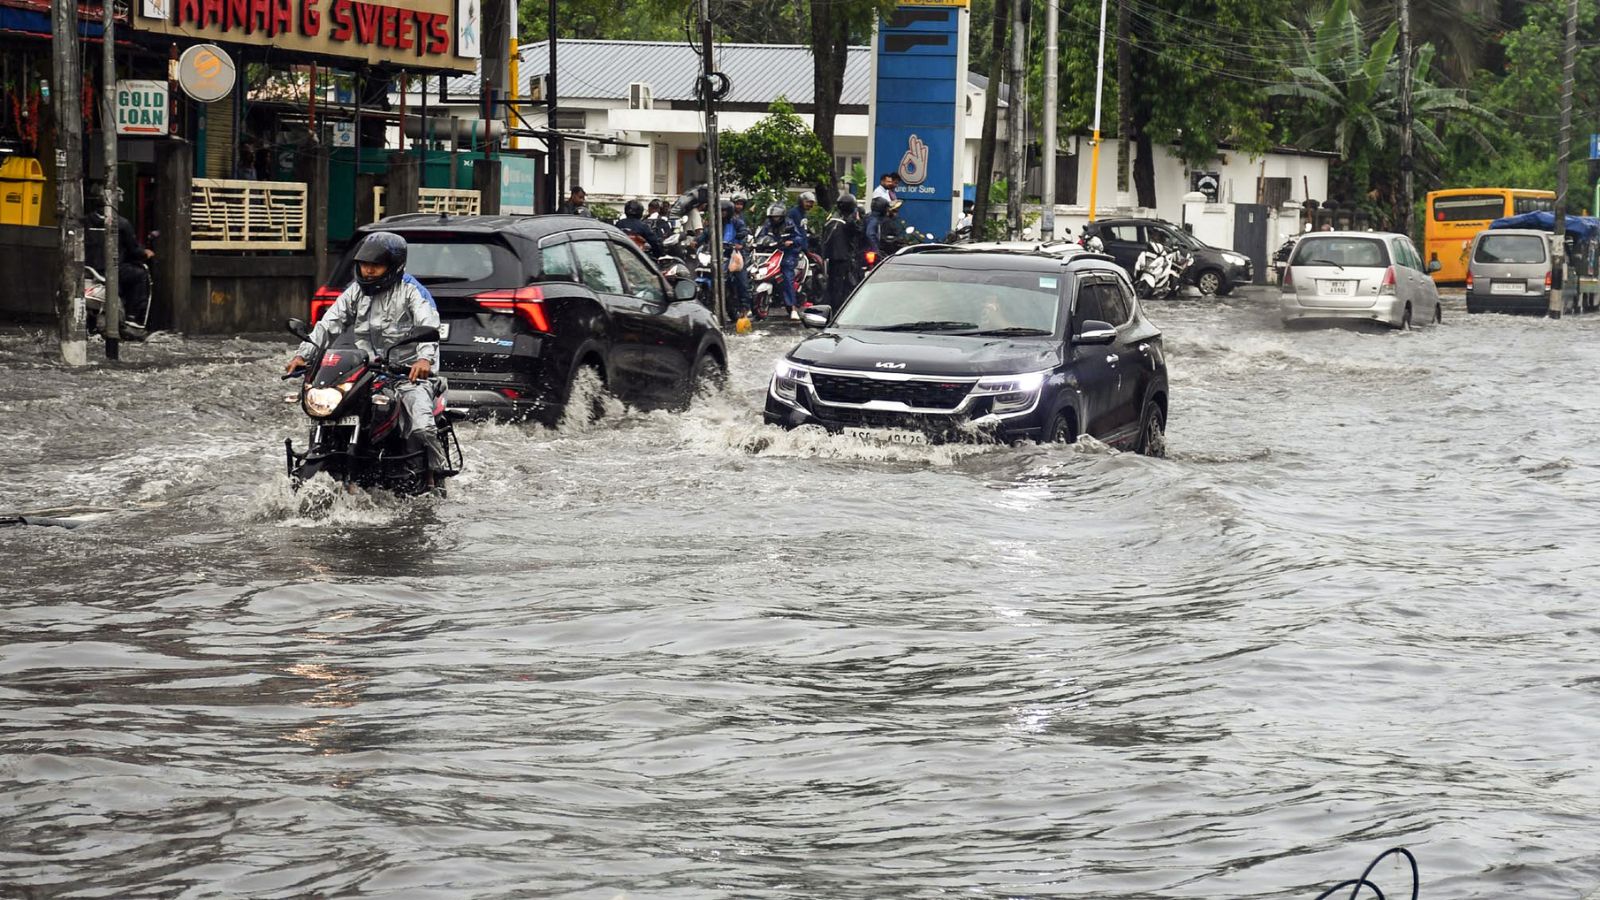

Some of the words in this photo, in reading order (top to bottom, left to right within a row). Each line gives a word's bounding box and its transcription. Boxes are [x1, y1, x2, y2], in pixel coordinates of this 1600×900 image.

[330, 0, 449, 57] SWEETS
[118, 91, 164, 107] GOLD
[118, 109, 163, 125] LOAN
[894, 185, 906, 193] ure
[918, 185, 936, 194] Sure
[875, 361, 907, 369] KIA
